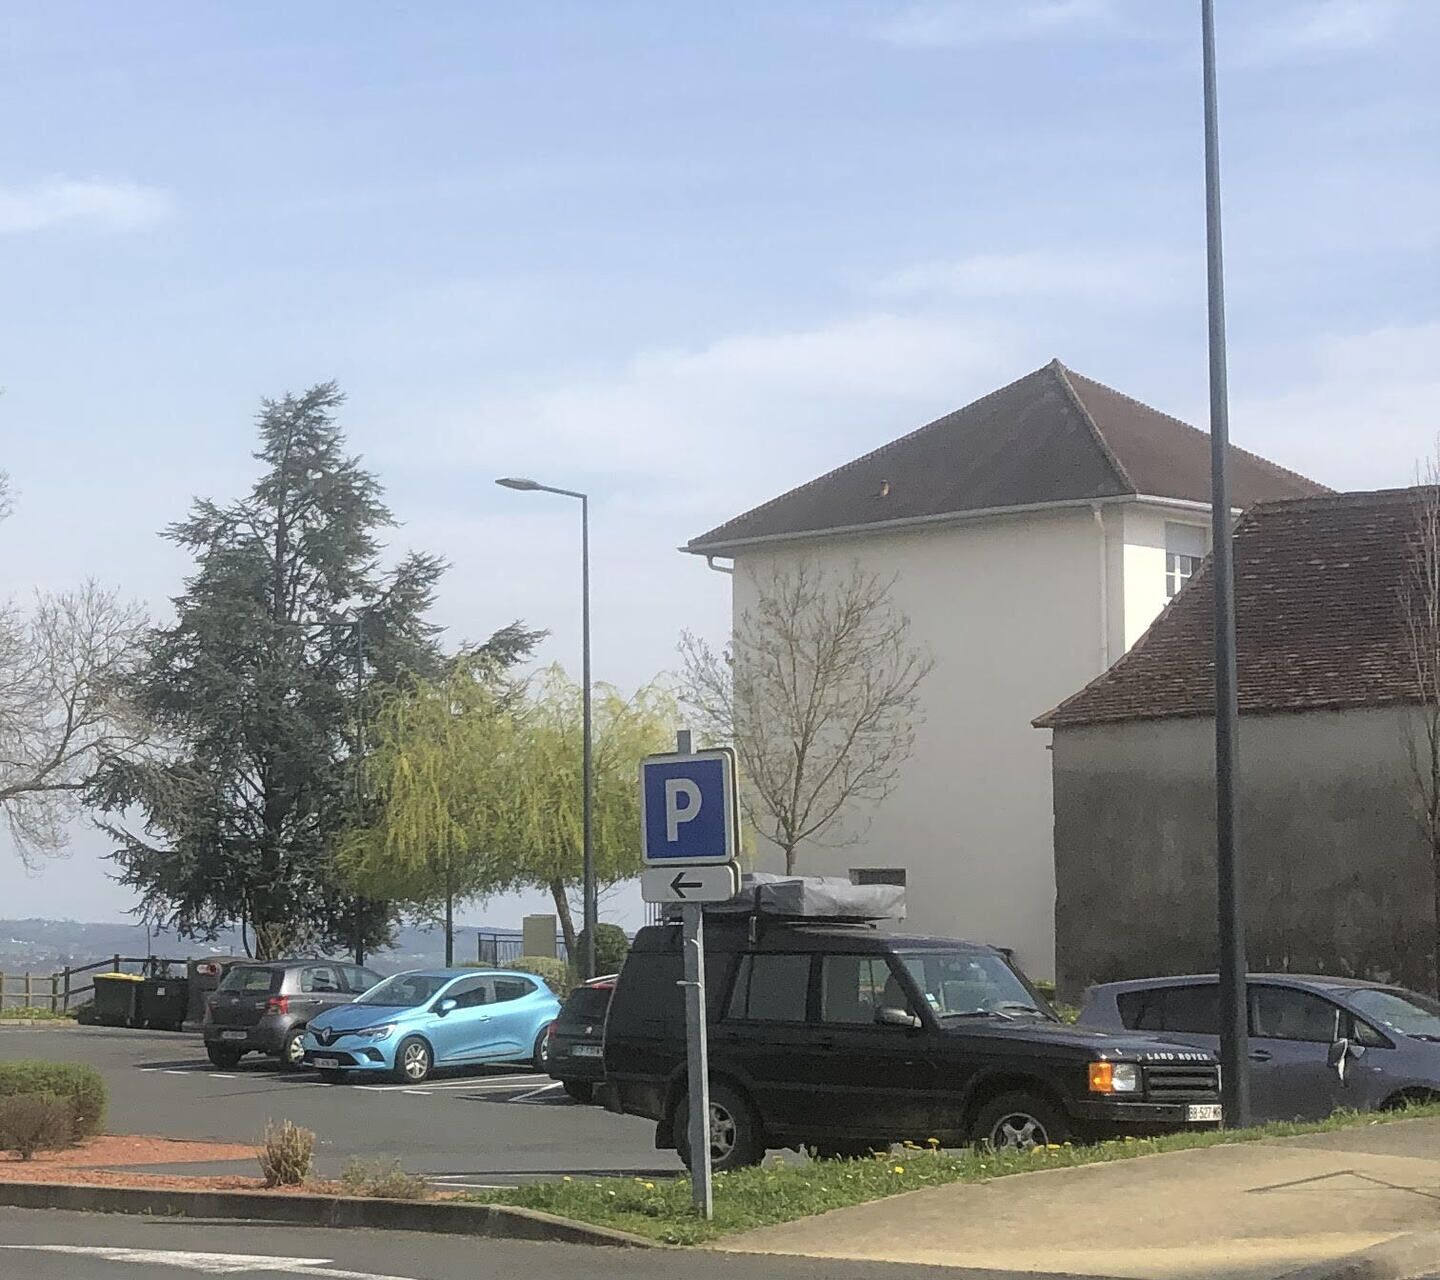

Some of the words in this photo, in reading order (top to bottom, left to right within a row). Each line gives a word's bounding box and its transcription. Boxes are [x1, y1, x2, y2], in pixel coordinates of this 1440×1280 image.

[665, 778, 702, 842] P
[1146, 1052, 1174, 1060] LAND
[1177, 1053, 1211, 1061] ROVER
